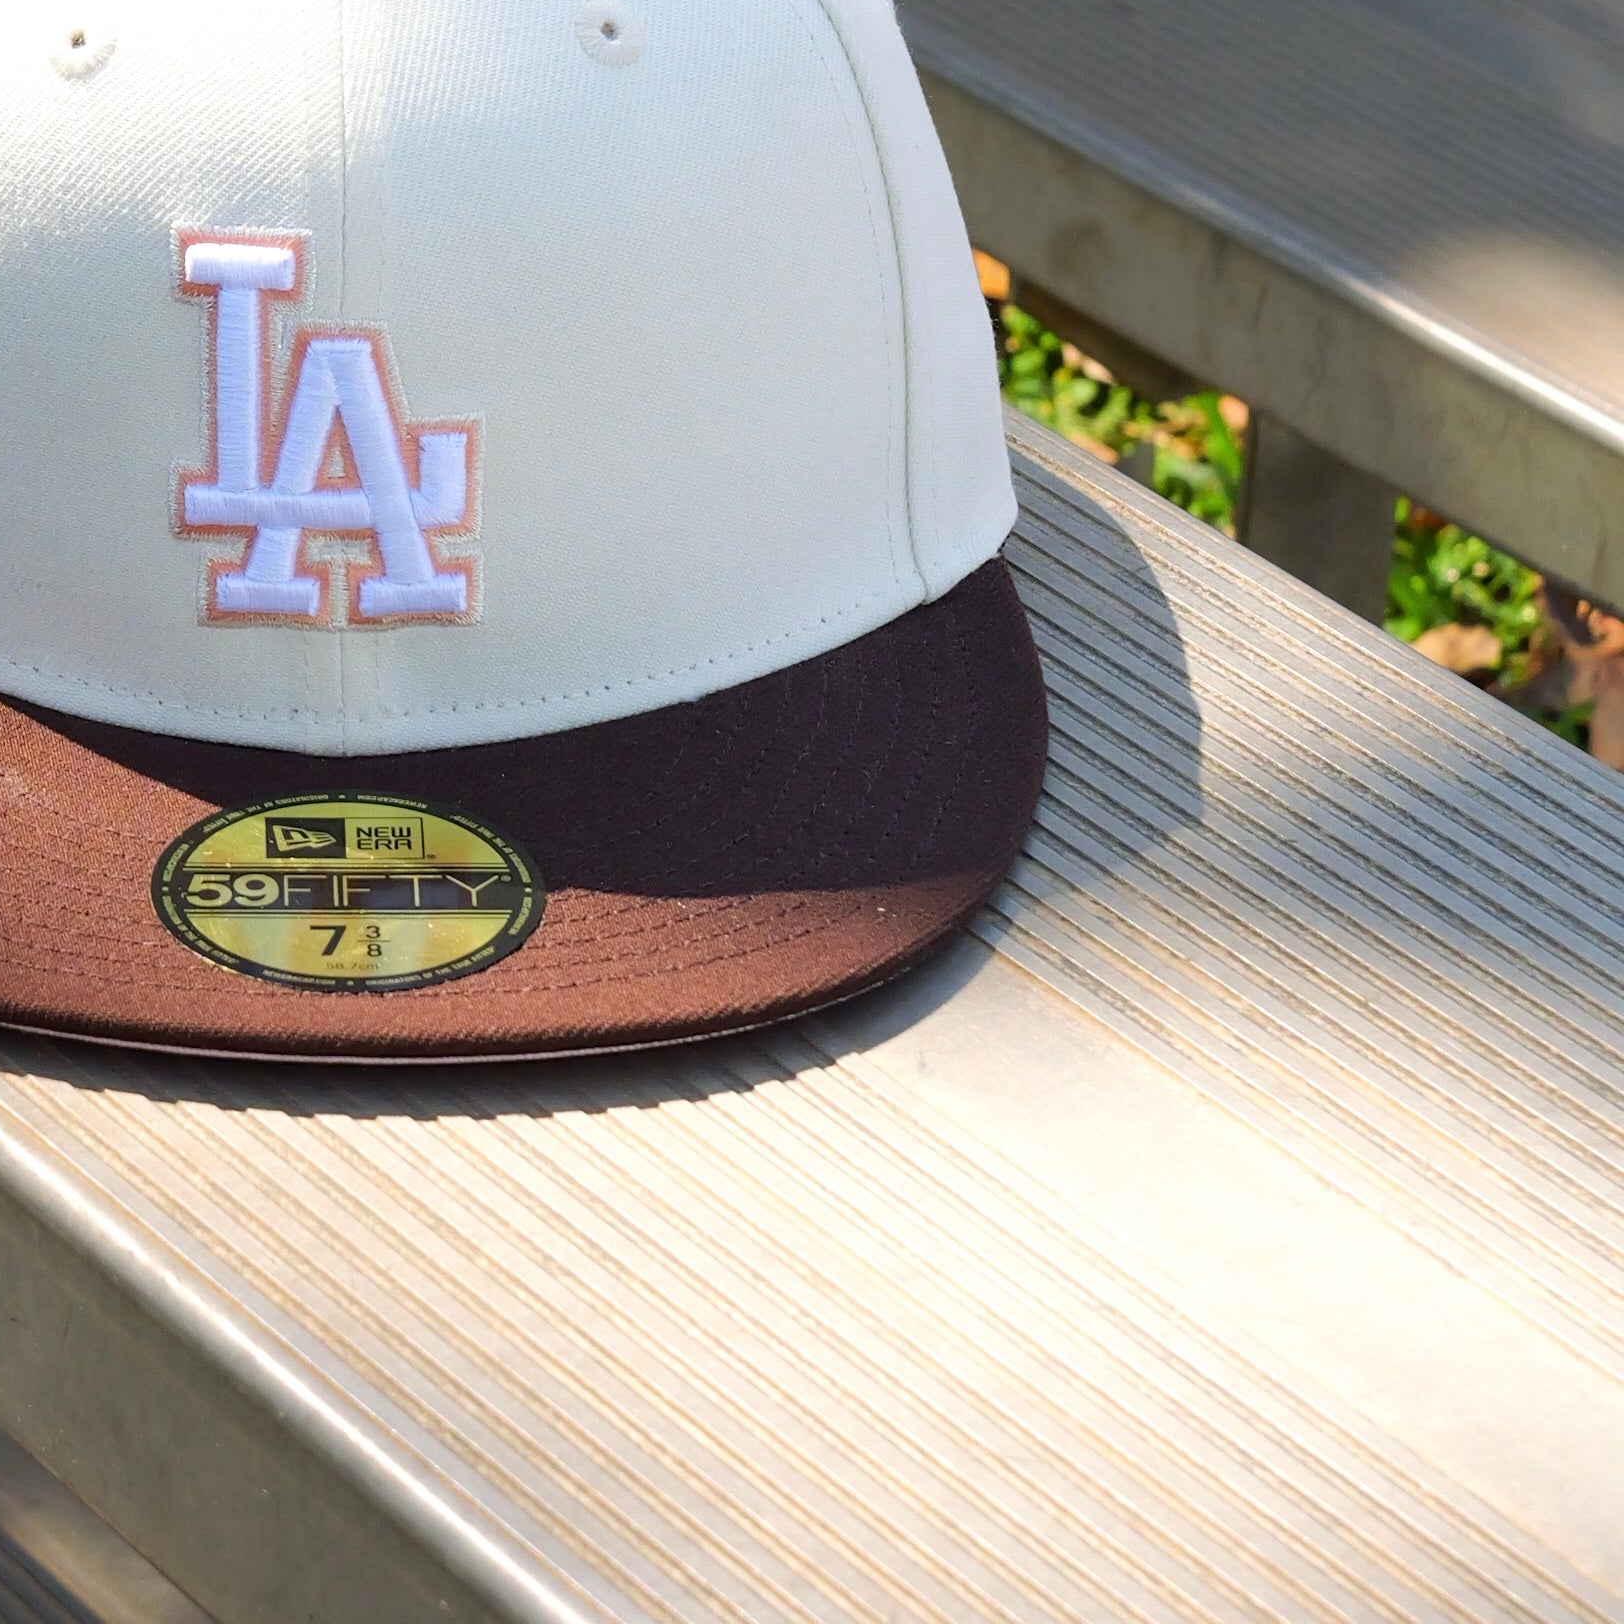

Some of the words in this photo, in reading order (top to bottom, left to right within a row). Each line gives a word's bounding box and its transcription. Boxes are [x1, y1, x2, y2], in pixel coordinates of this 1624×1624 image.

[178, 232, 478, 624] LA
[356, 826, 411, 838] NEW
[357, 838, 412, 850] ERA
[186, 873, 499, 908] 59FIFTY
[310, 925, 347, 956] 7
